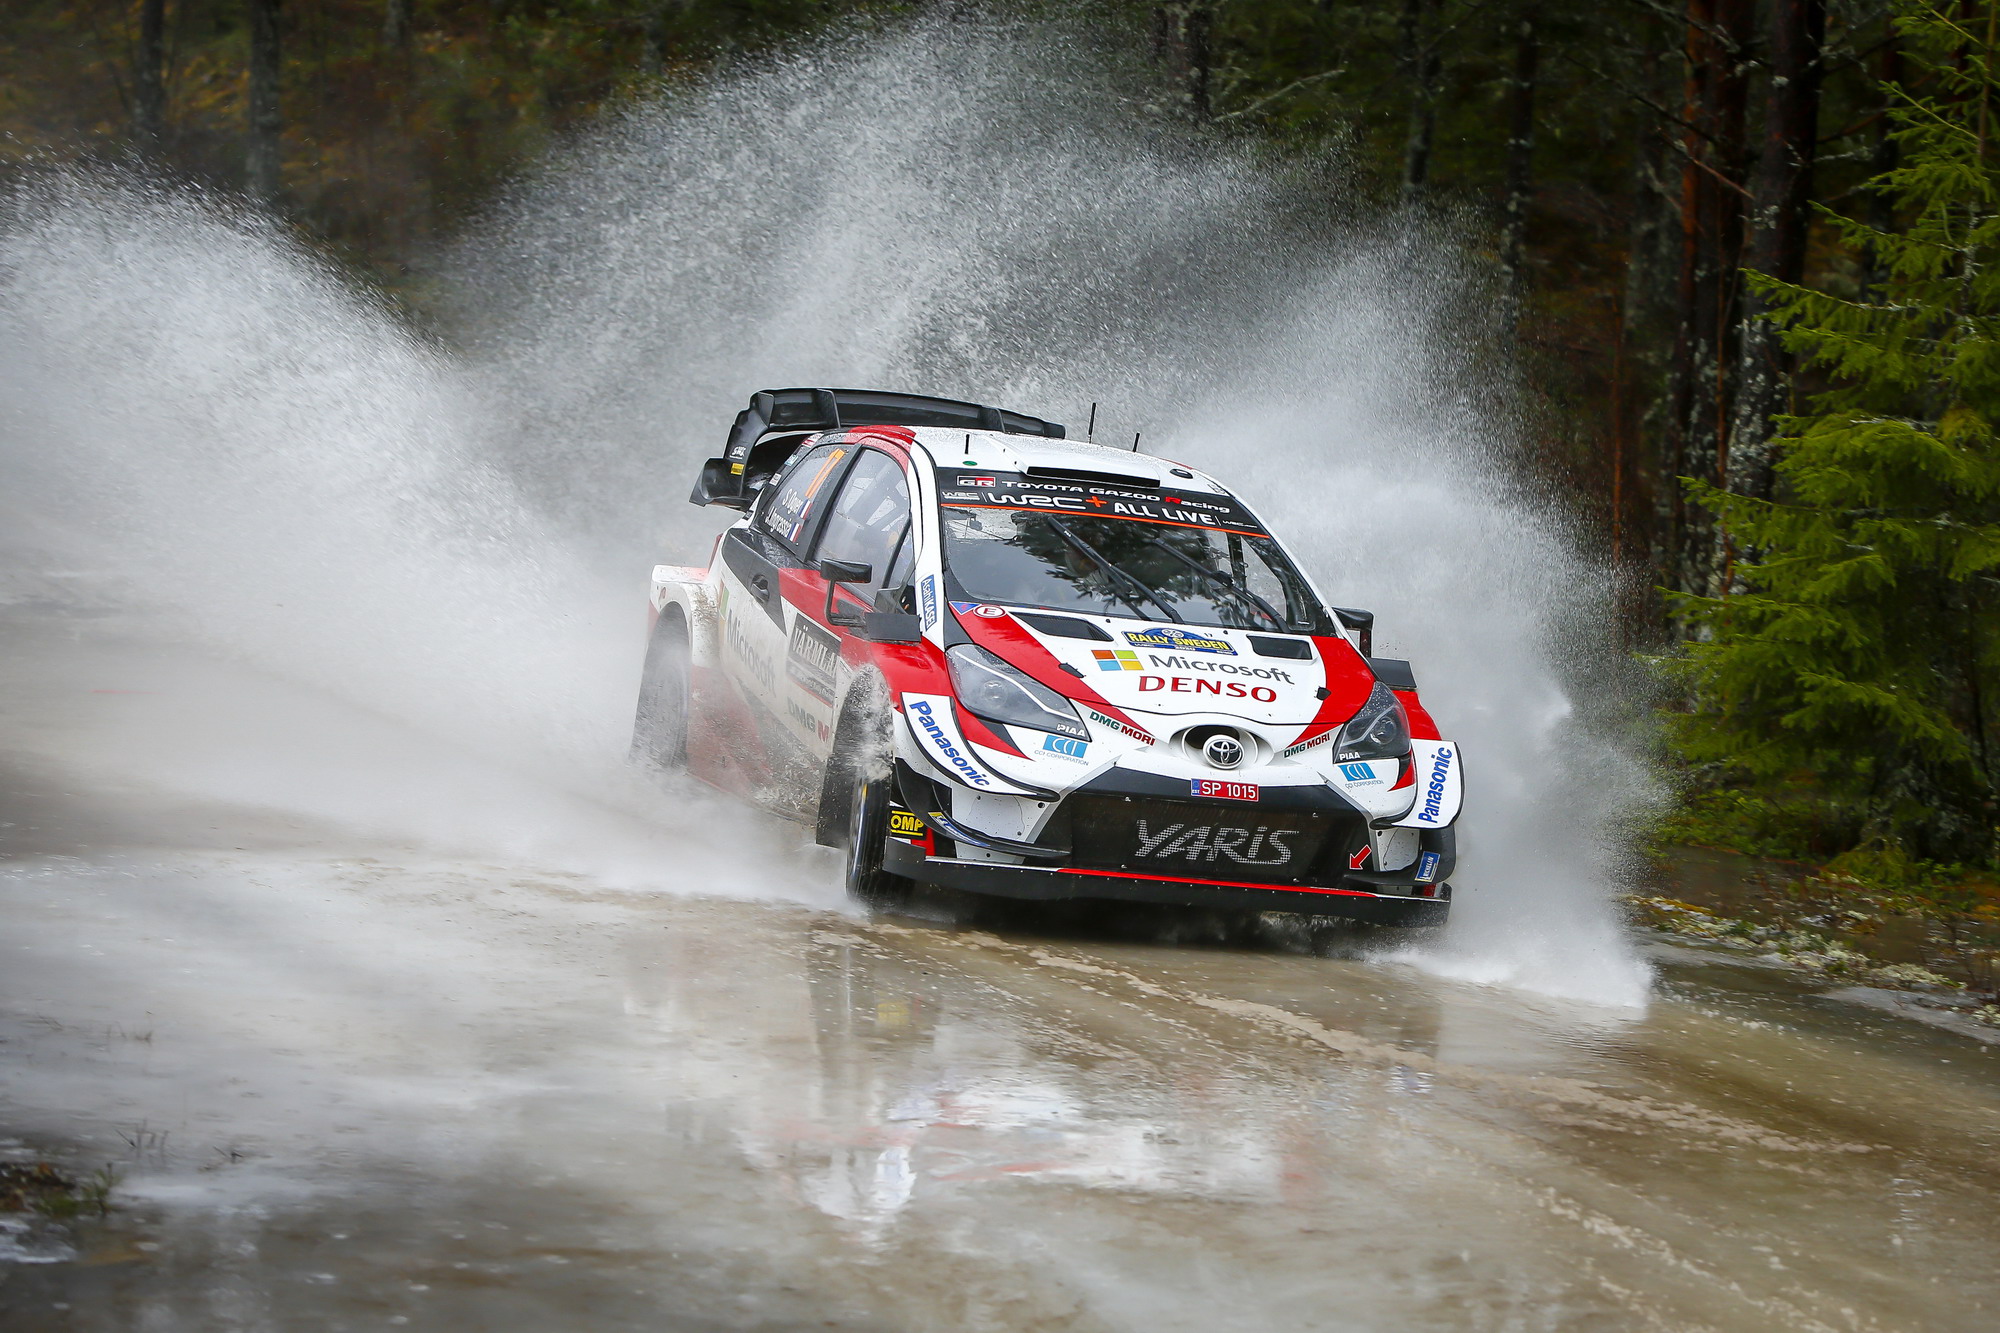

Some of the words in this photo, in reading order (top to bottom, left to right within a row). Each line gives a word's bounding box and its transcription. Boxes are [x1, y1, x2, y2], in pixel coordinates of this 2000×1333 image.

[958, 478, 995, 487] GR
[1002, 480, 1085, 493] TOYOTA
[1089, 486, 1161, 502] GAZOO
[1164, 496, 1230, 513] Racing
[1114, 503, 1158, 518] ALL
[1162, 508, 1216, 525] LIVE
[984, 607, 996, 615] E
[727, 608, 776, 698] Microsoft
[1126, 632, 1169, 644] RALLY
[1172, 637, 1230, 650] SWEDEN
[1148, 654, 1295, 685] Microsoft
[1138, 675, 1277, 703] DENSO
[787, 696, 815, 733] DMG
[1056, 723, 1086, 737] PIAA
[1089, 711, 1120, 731] DMG
[1120, 725, 1156, 746] MORI
[909, 700, 990, 787] Panasonic
[1283, 743, 1306, 759] DMG
[1306, 733, 1331, 750] MORI
[1339, 751, 1361, 760] PIAA
[1046, 752, 1089, 766] CORPORATION
[1201, 781, 1222, 796] SP
[1226, 783, 1256, 799] 1015
[1417, 747, 1453, 824] Panasonic
[890, 814, 924, 832] OMP
